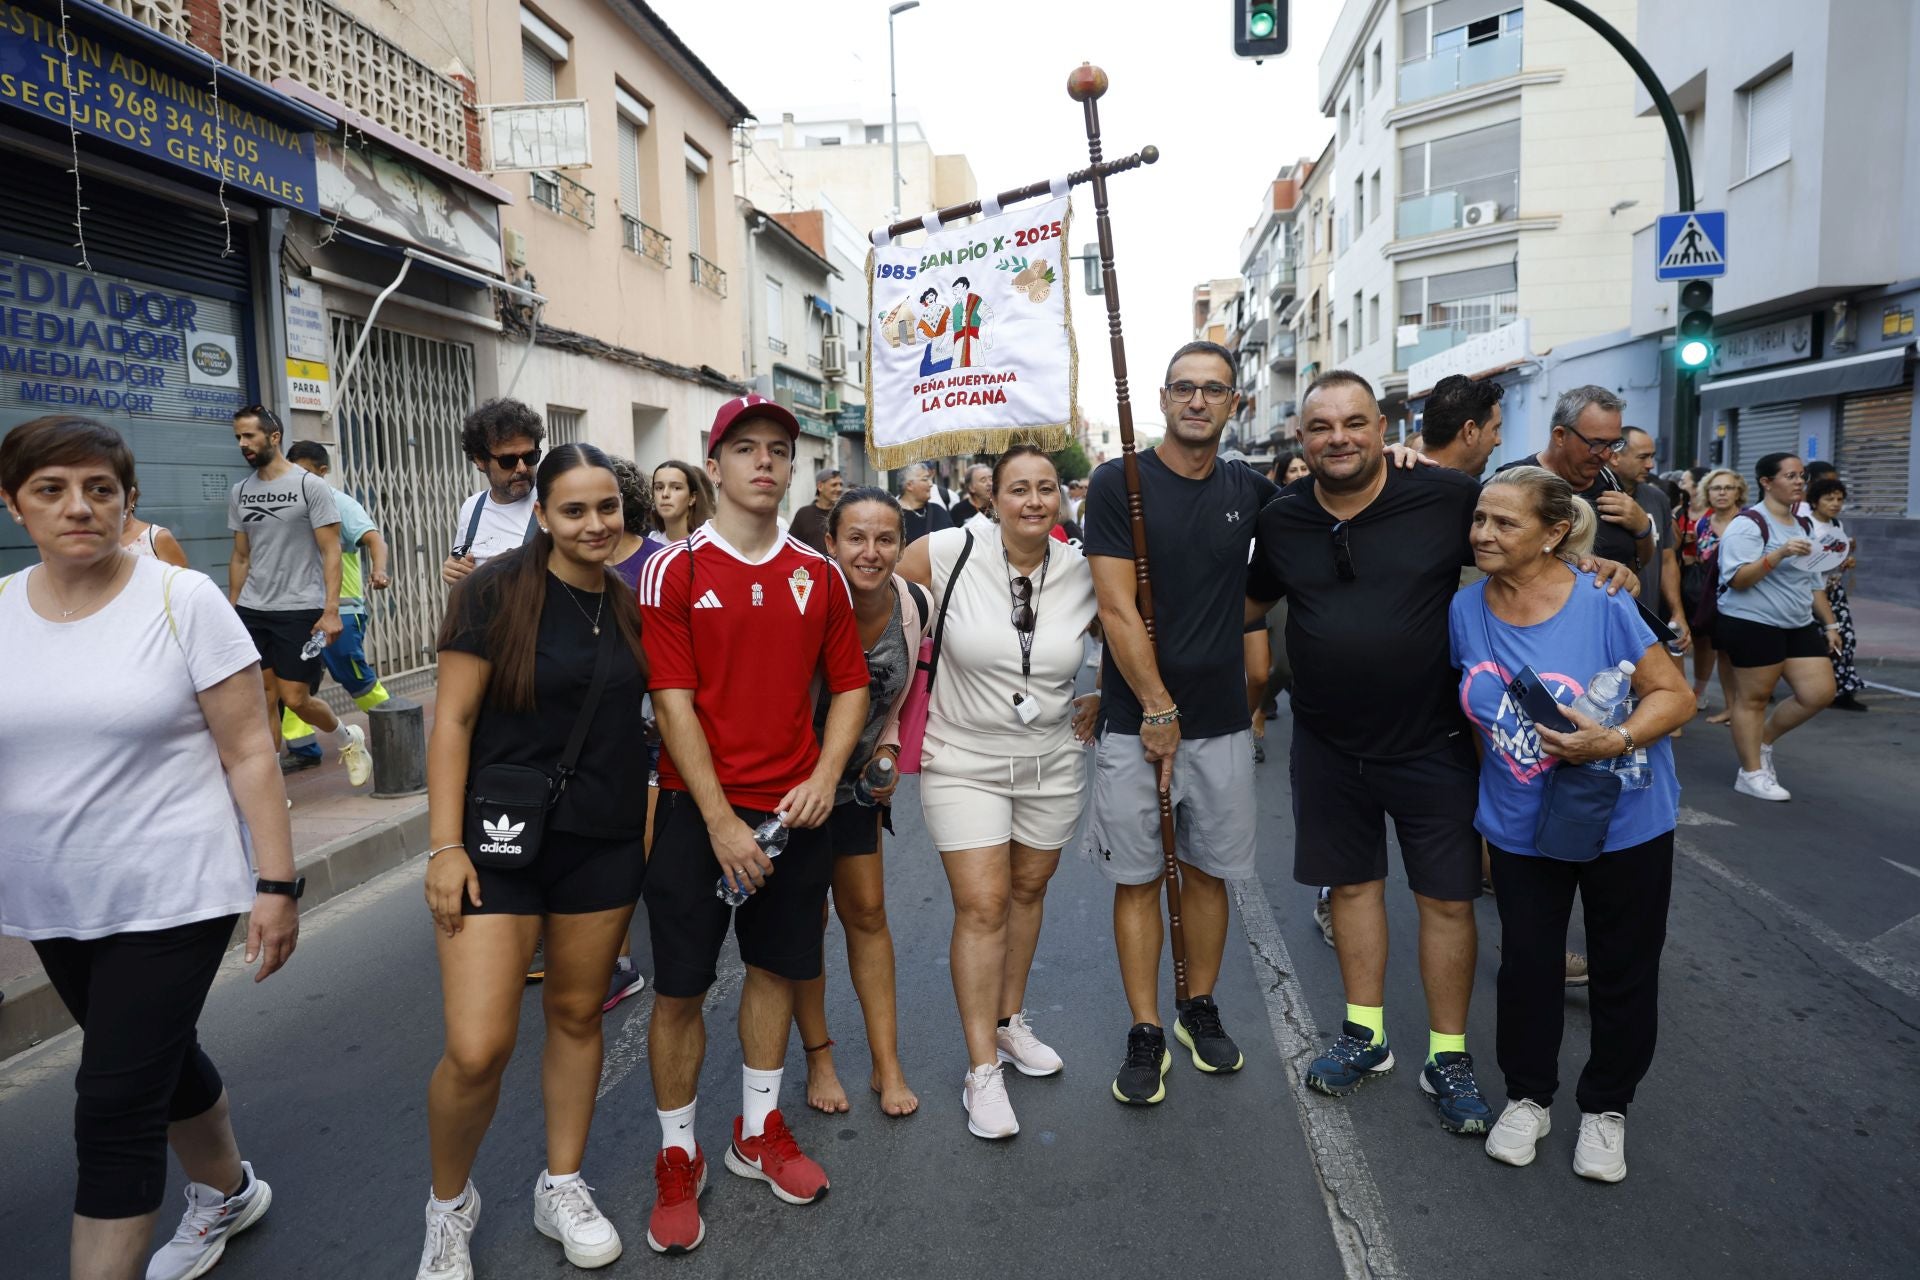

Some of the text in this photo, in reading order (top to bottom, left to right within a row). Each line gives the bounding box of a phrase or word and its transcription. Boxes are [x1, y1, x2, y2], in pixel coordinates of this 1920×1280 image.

[41, 53, 259, 163] TLF: 968 34 45 05
[110, 52, 303, 154] ADMINISTRATIVA
[1, 73, 304, 204] SEGUROS GENERALES
[877, 263, 917, 280] 1985
[919, 250, 953, 273] SAN
[0, 305, 180, 362] EDIADOR
[0, 344, 165, 388] MEDIADOR
[21, 381, 153, 413] MEDIADOR
[293, 382, 321, 393] PARRA
[913, 372, 1017, 395] PEÑA HUERTANA
[295, 396, 321, 406] SEGUROS
[922, 396, 941, 412] LA
[241, 491, 298, 506] Reebok
[480, 842, 522, 854] adidas
